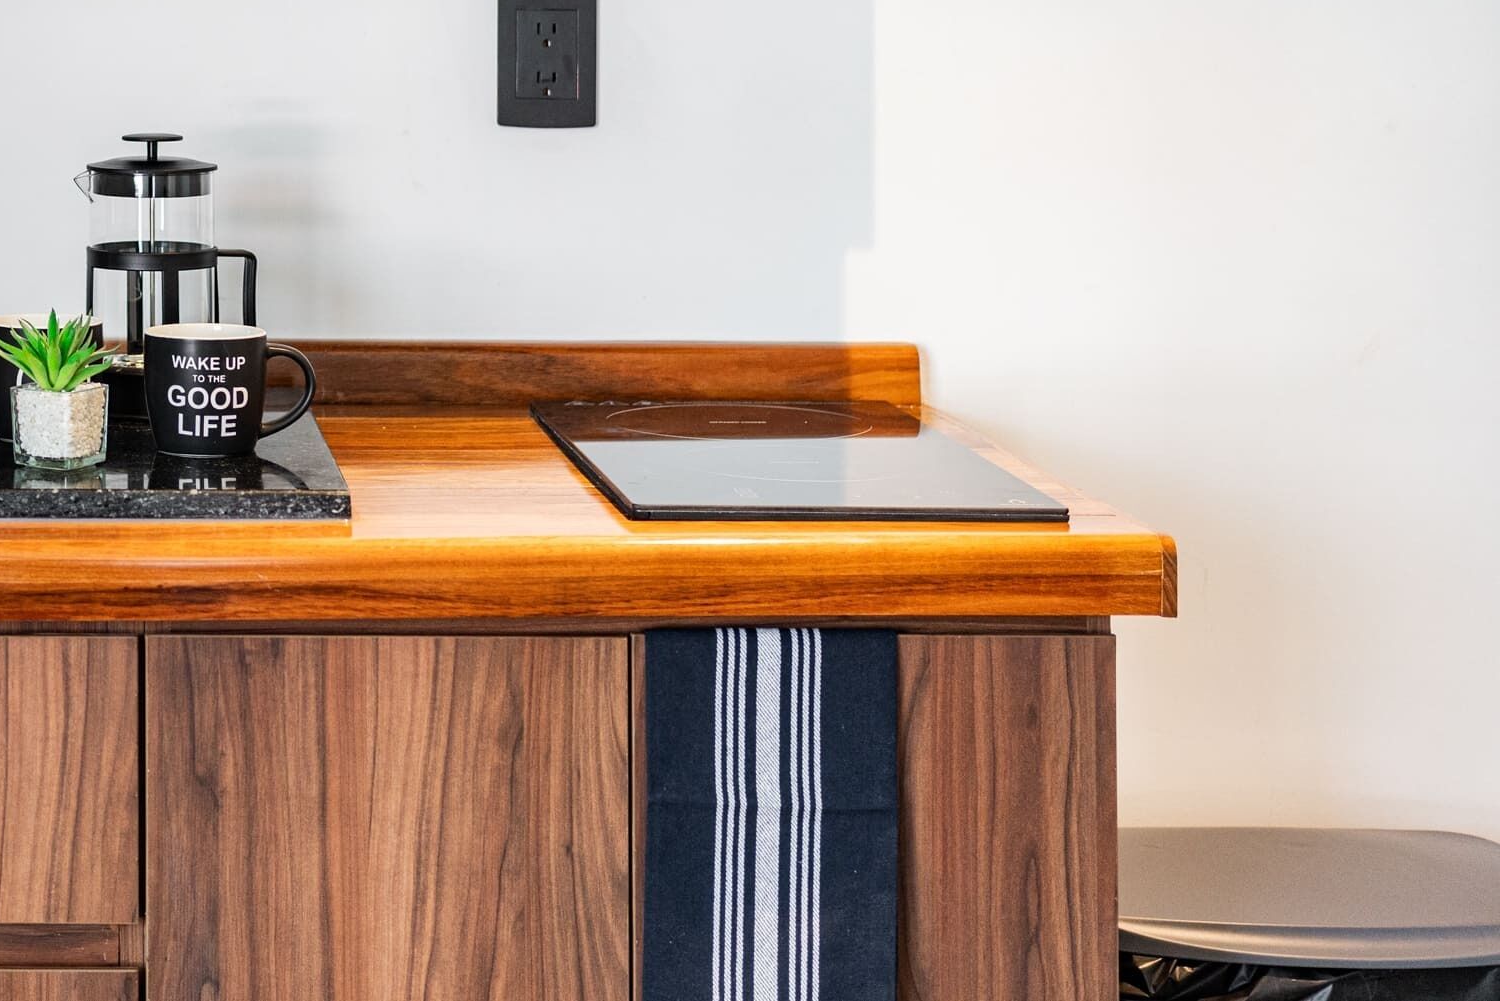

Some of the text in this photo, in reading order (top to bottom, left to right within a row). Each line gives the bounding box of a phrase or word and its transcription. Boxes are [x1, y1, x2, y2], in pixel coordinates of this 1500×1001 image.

[172, 354, 246, 371] WAKE UP
[192, 374, 226, 383] TO THE
[167, 385, 249, 410] GOOD
[178, 413, 237, 437] LIFE
